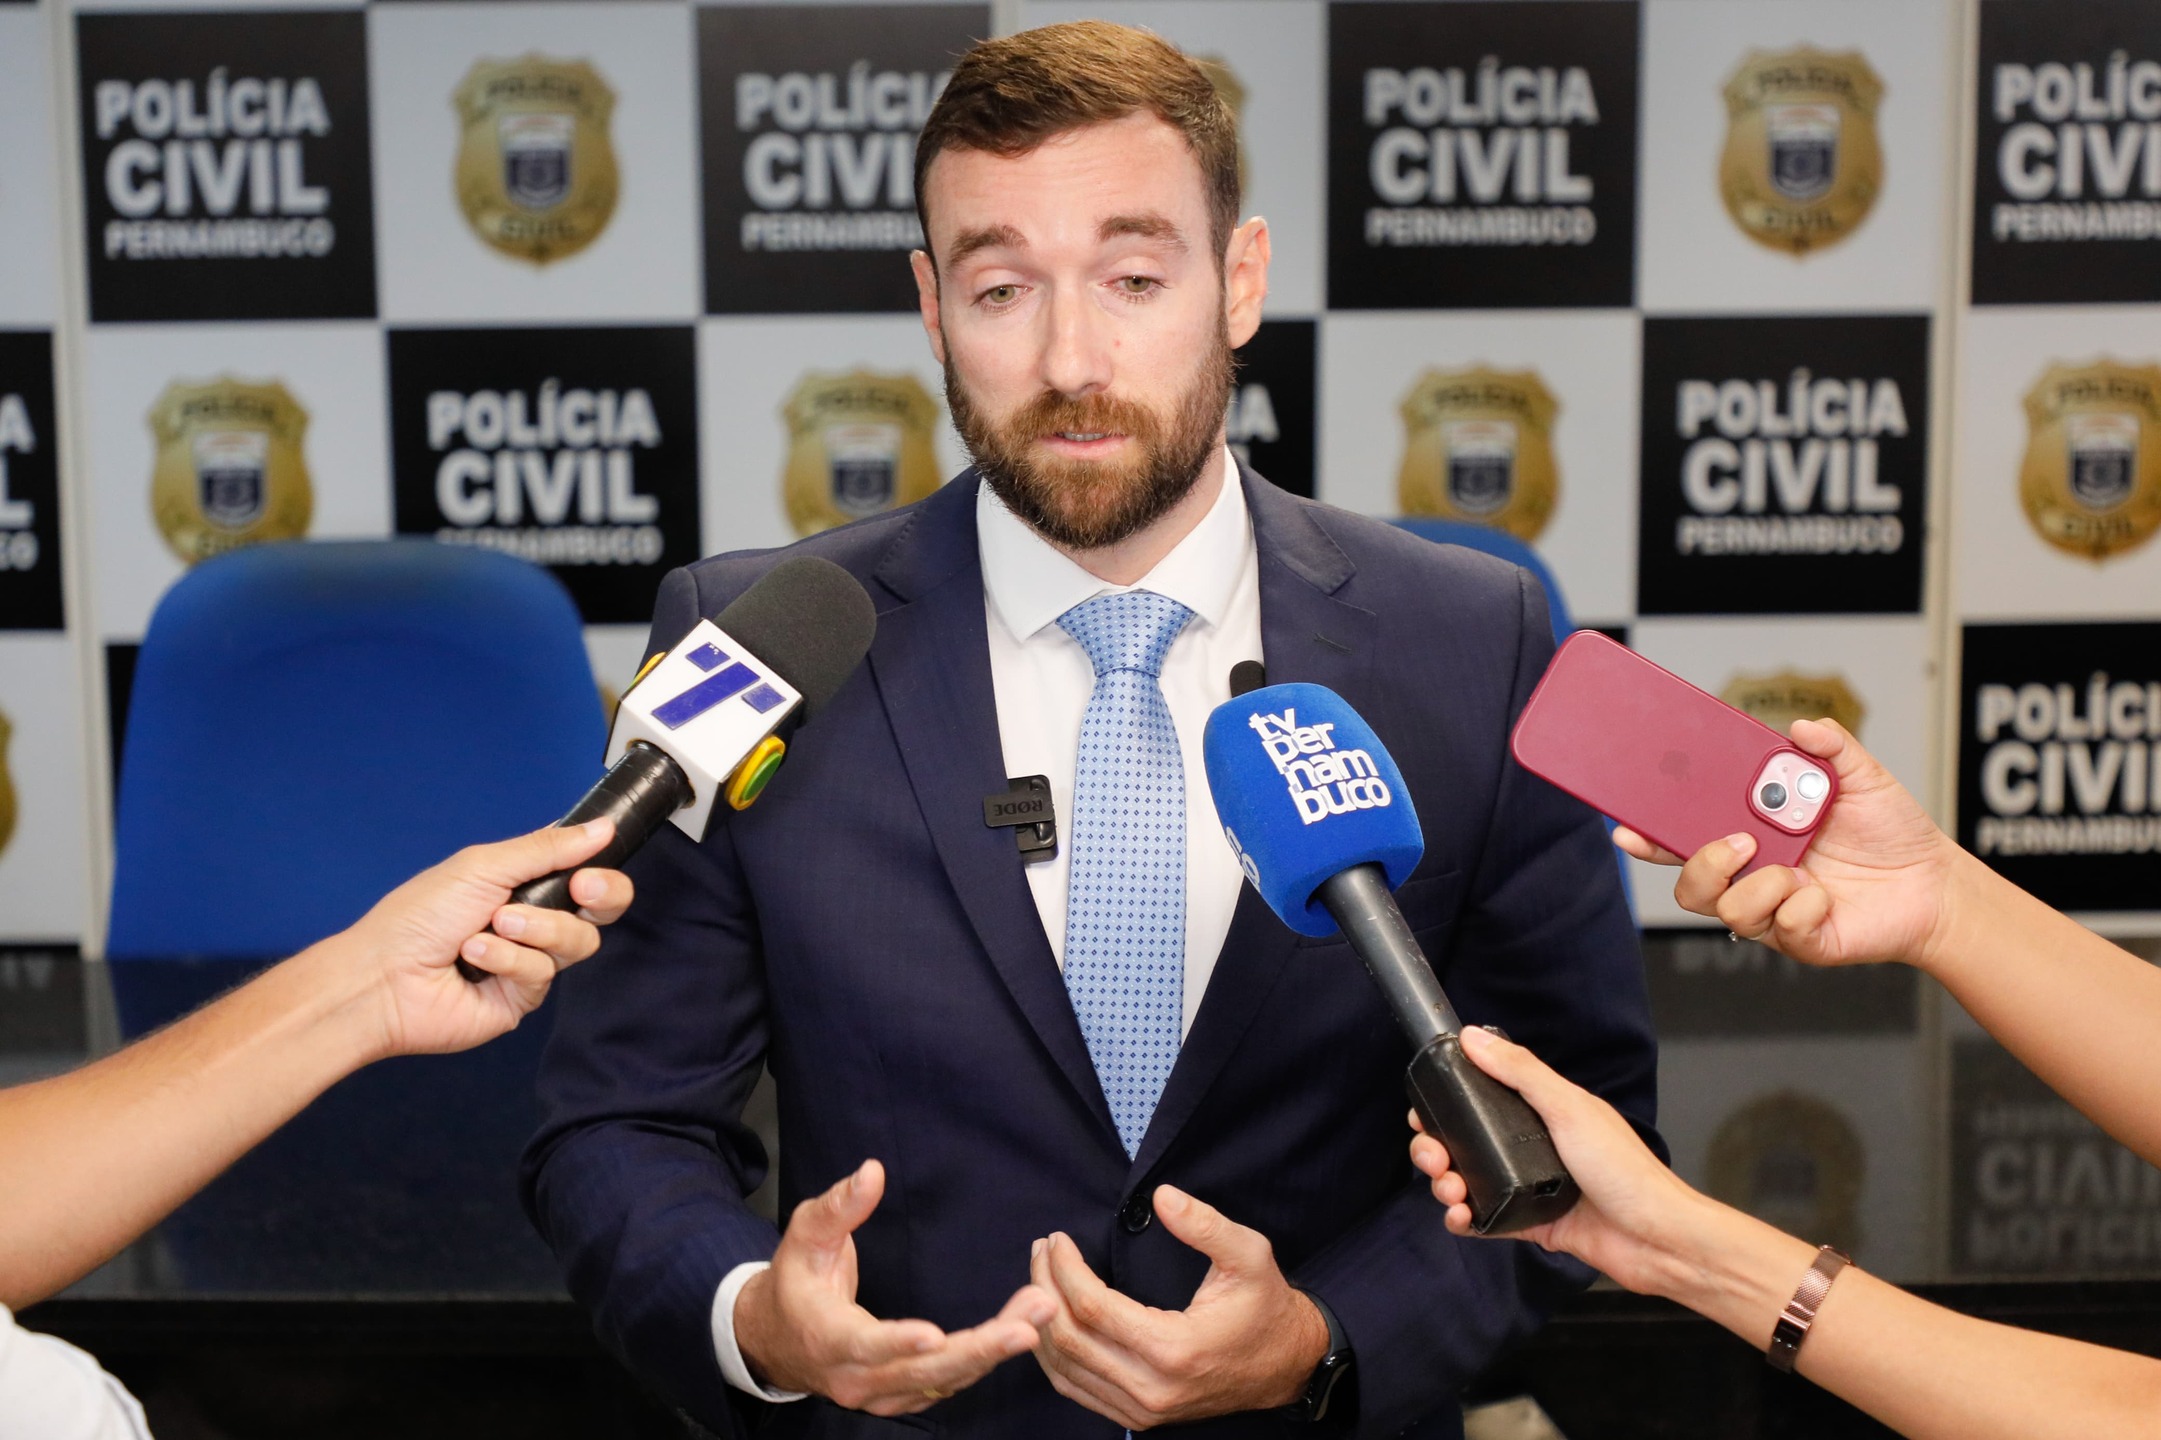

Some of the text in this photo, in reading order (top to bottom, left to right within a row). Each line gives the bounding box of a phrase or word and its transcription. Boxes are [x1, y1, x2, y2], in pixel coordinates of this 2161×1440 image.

[97, 66, 331, 138] POLÍCIA
[1363, 55, 1600, 126] POLÍCIA
[1993, 50, 2161, 122] POLÍC
[105, 138, 330, 217] CIVIL
[743, 131, 916, 209] CIVI
[1369, 126, 1594, 204] CIVIL
[1998, 122, 2161, 200] CIVI
[105, 218, 335, 259] PERNAMBUCO
[741, 210, 926, 251] PERNAMBU
[1364, 206, 1597, 247] PERNAMBUCO
[1992, 202, 2161, 241] PERNAMB
[427, 377, 662, 449] POLÍCIA
[1677, 366, 1909, 437] POLÍCIA
[436, 449, 659, 525] CIVIL
[1682, 437, 1901, 514] CIVIL
[1677, 515, 1904, 554] PERNAMBUCO
[1249, 708, 1297, 742] tv
[1976, 671, 2161, 743] POLÍCI
[1262, 722, 1336, 775] per
[1283, 749, 1380, 793] nam
[1980, 740, 2161, 816] CIVI
[1288, 776, 1393, 825] buco
[1976, 816, 2161, 855] PERNAMBU
